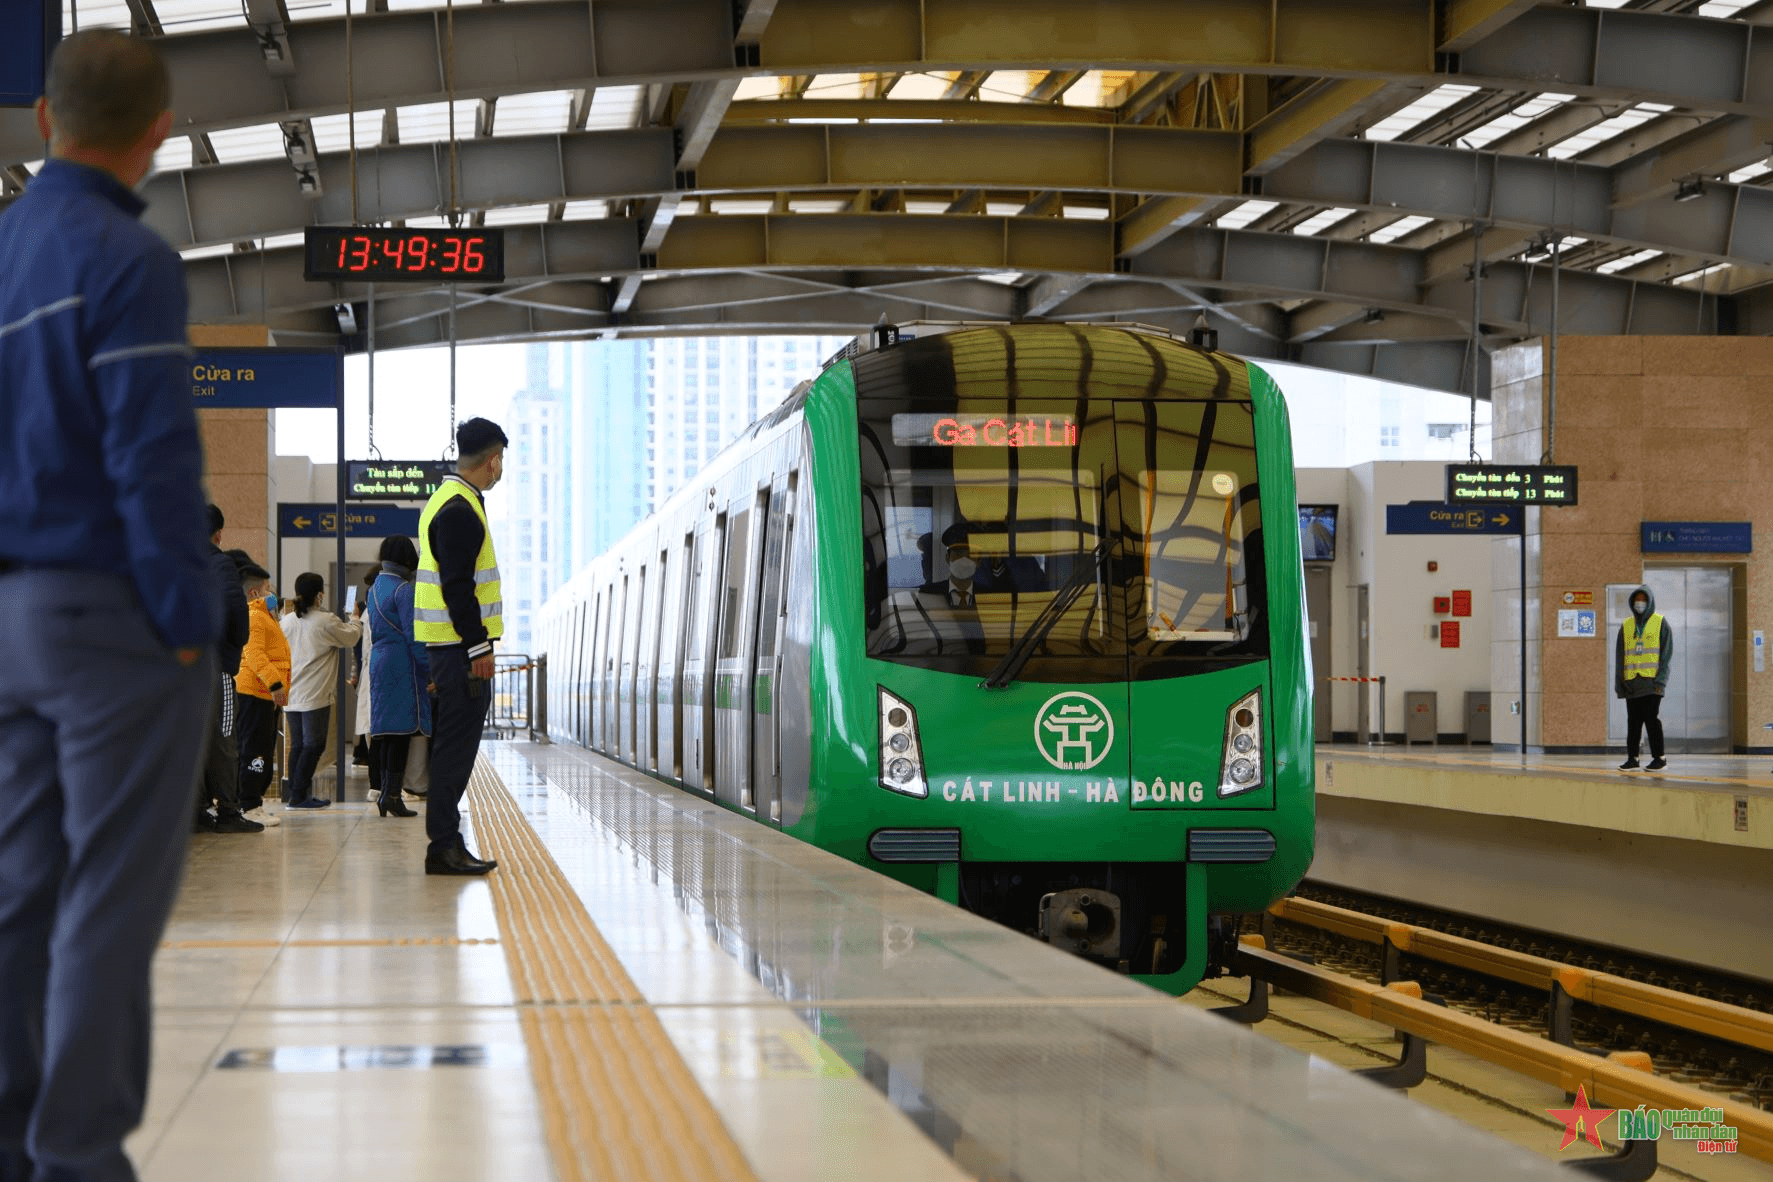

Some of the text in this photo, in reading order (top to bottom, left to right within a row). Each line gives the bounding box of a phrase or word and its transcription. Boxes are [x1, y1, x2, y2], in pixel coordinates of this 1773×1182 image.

[338, 236, 485, 272] 13:49:36
[192, 363, 255, 381] Cửa ra
[192, 385, 216, 397] Exit
[933, 418, 976, 446] Ga
[983, 418, 1037, 447] Cát
[1524, 474, 1531, 483] 3
[1525, 489, 1536, 499] 13
[1454, 512, 1465, 520] ra
[943, 776, 993, 802] CÁT
[1003, 781, 1060, 802] LINH
[1086, 777, 1119, 802] HÀ
[1134, 777, 1204, 802] ĐÔNG
